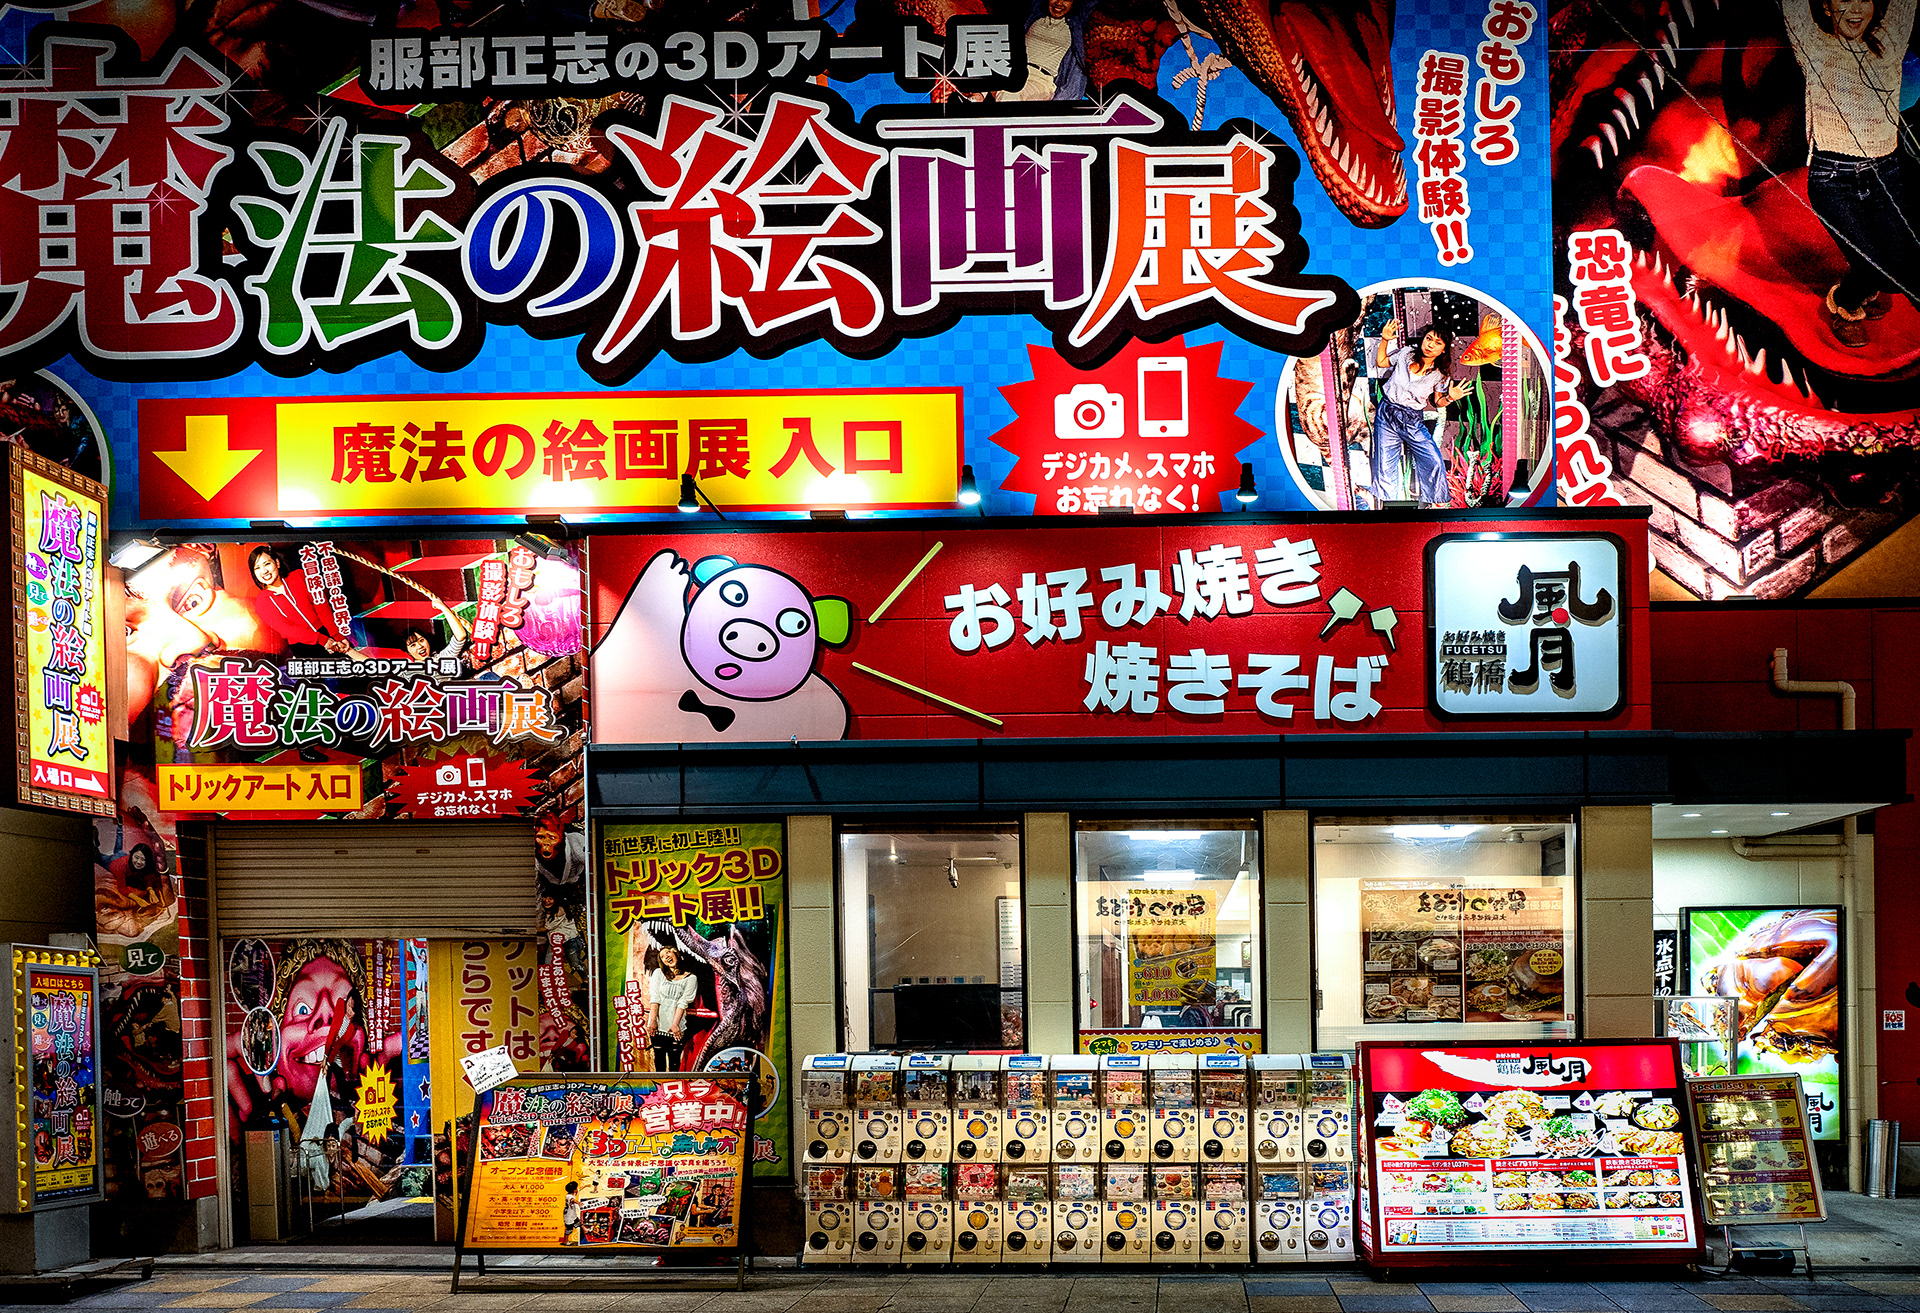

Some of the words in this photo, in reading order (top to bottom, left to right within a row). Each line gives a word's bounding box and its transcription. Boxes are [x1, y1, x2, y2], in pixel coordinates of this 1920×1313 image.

[368, 22, 1013, 92] 服部正志の3Dアート展
[1473, 0, 1535, 163] おもしろ
[1415, 51, 1470, 264] 撮影体験!!
[0, 36, 1335, 363] 魔法の絵画展
[1573, 233, 1647, 383] 恐竜に
[331, 418, 750, 484] 魔法の絵画展
[768, 417, 903, 478] 入口
[1042, 450, 1216, 482] デジカメ、スマホ
[1056, 483, 1201, 512] お忘れなく!
[28, 582, 49, 601] 見て
[299, 544, 326, 605] 大冒険!!
[316, 541, 351, 636] 不思議の世界を
[502, 546, 537, 627] おもしろ
[944, 536, 1323, 652] お好み焼き
[39, 490, 88, 760] 魔法の絵画展
[472, 560, 504, 660] 撮影体験!!
[1498, 560, 1614, 694] 風月
[287, 659, 459, 677] 服部正志の3Dアート展
[1446, 646, 1503, 654] FUGETSU
[1083, 641, 1389, 722] 焼きそば
[1440, 659, 1506, 688] 鶴橋
[190, 663, 562, 749] 魔法の絵画展
[34, 764, 73, 788] 入場口
[168, 773, 303, 802] トリックアート
[308, 774, 352, 802] 入口
[416, 789, 513, 806] デジカメ、スマホ
[434, 802, 497, 817] お忘れなく!
[604, 827, 741, 856] 新世界に初上陸!!
[605, 846, 782, 895] トリック3D
[609, 884, 764, 932] アート展!!
[127, 948, 158, 968] 見て
[552, 934, 572, 1007] きっとあなたも
[1655, 938, 1674, 996] 氷点下の
[35, 977, 85, 989] 入場口はこちら
[540, 965, 567, 1029] だまされる!!
[613, 995, 632, 1072] 撮って楽しい!!
[626, 981, 646, 1049] 見て楽しい!!
[48, 991, 78, 1167] 魔法の絵画展
[1522, 1053, 1587, 1083] 風月
[1692, 1083, 1726, 1092] Special
[1727, 1082, 1744, 1090] Set
[104, 1088, 141, 1109] 触って
[491, 1087, 634, 1116] 魔法の絵画展
[662, 1079, 713, 1100] 只今
[543, 1116, 592, 1127] museum
[641, 1101, 747, 1135] 営業中!!
[141, 1130, 179, 1150] 遊べる
[589, 1131, 738, 1158] 3Dアートの楽しみ方
[490, 1167, 563, 1176] オープン記念価格
